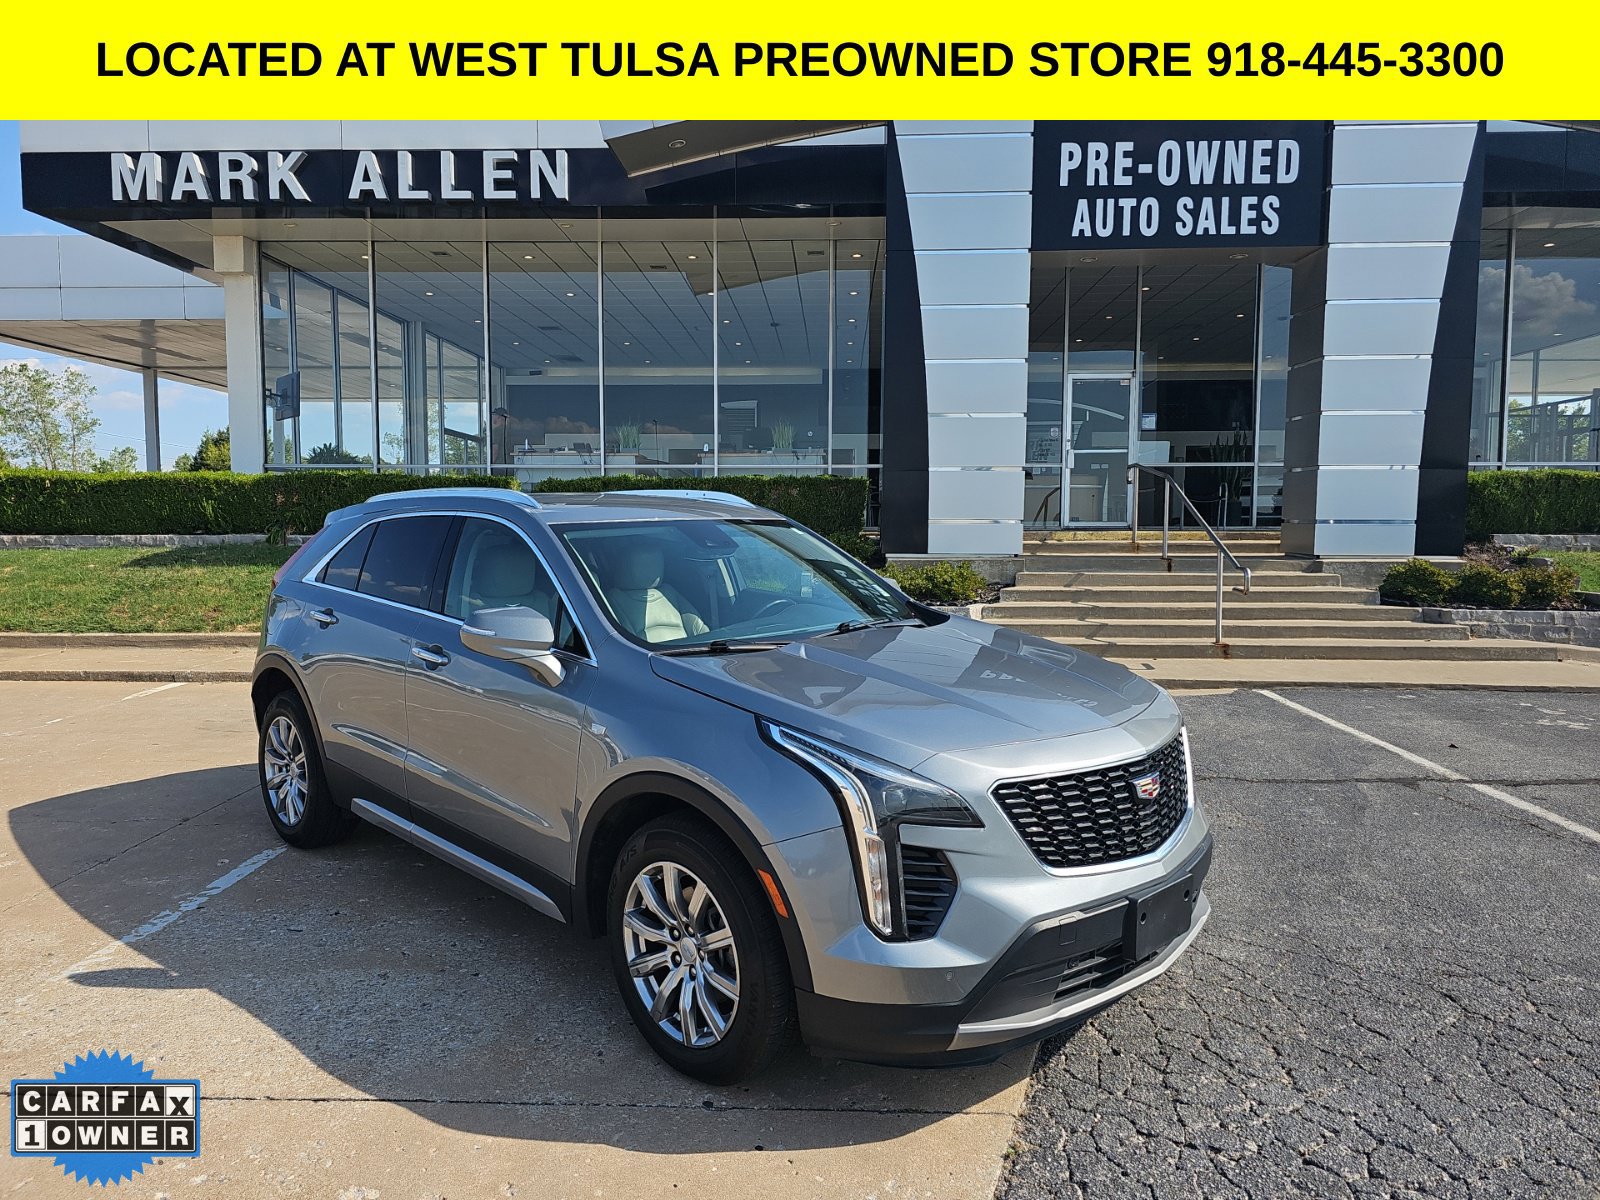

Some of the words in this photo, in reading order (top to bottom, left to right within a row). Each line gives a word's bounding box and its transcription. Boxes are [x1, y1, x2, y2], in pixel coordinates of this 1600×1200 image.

[110, 151, 312, 202] MARK
[348, 150, 569, 201] ALLEN
[1059, 139, 1300, 186] PRE-OWNED
[1071, 196, 1160, 237] AUTO
[1175, 195, 1280, 236] SALES
